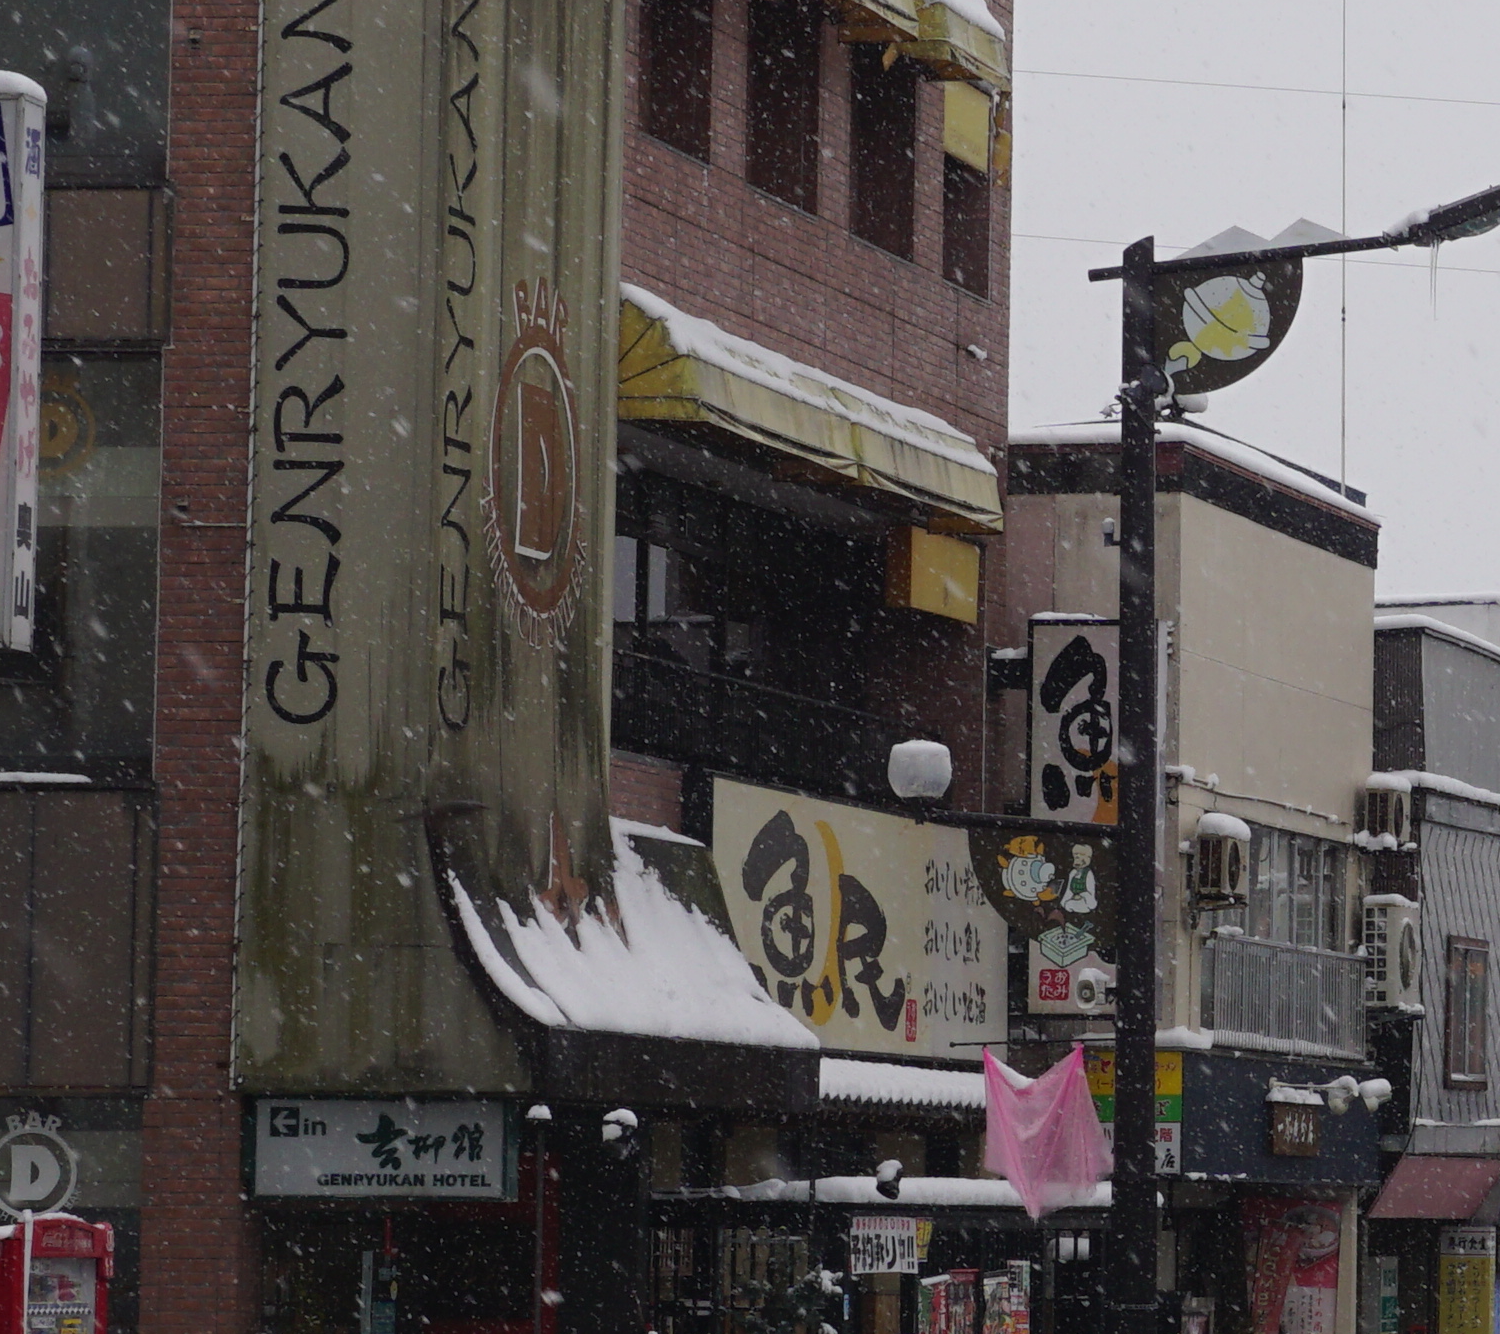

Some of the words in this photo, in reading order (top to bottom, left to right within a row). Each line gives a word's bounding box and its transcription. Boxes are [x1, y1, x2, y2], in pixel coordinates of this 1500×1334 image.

[6, 1110, 62, 1132] BAR
[303, 1118, 328, 1136] in
[316, 1173, 426, 1187] GENRYUKAN
[432, 1173, 492, 1188] HOTEL
